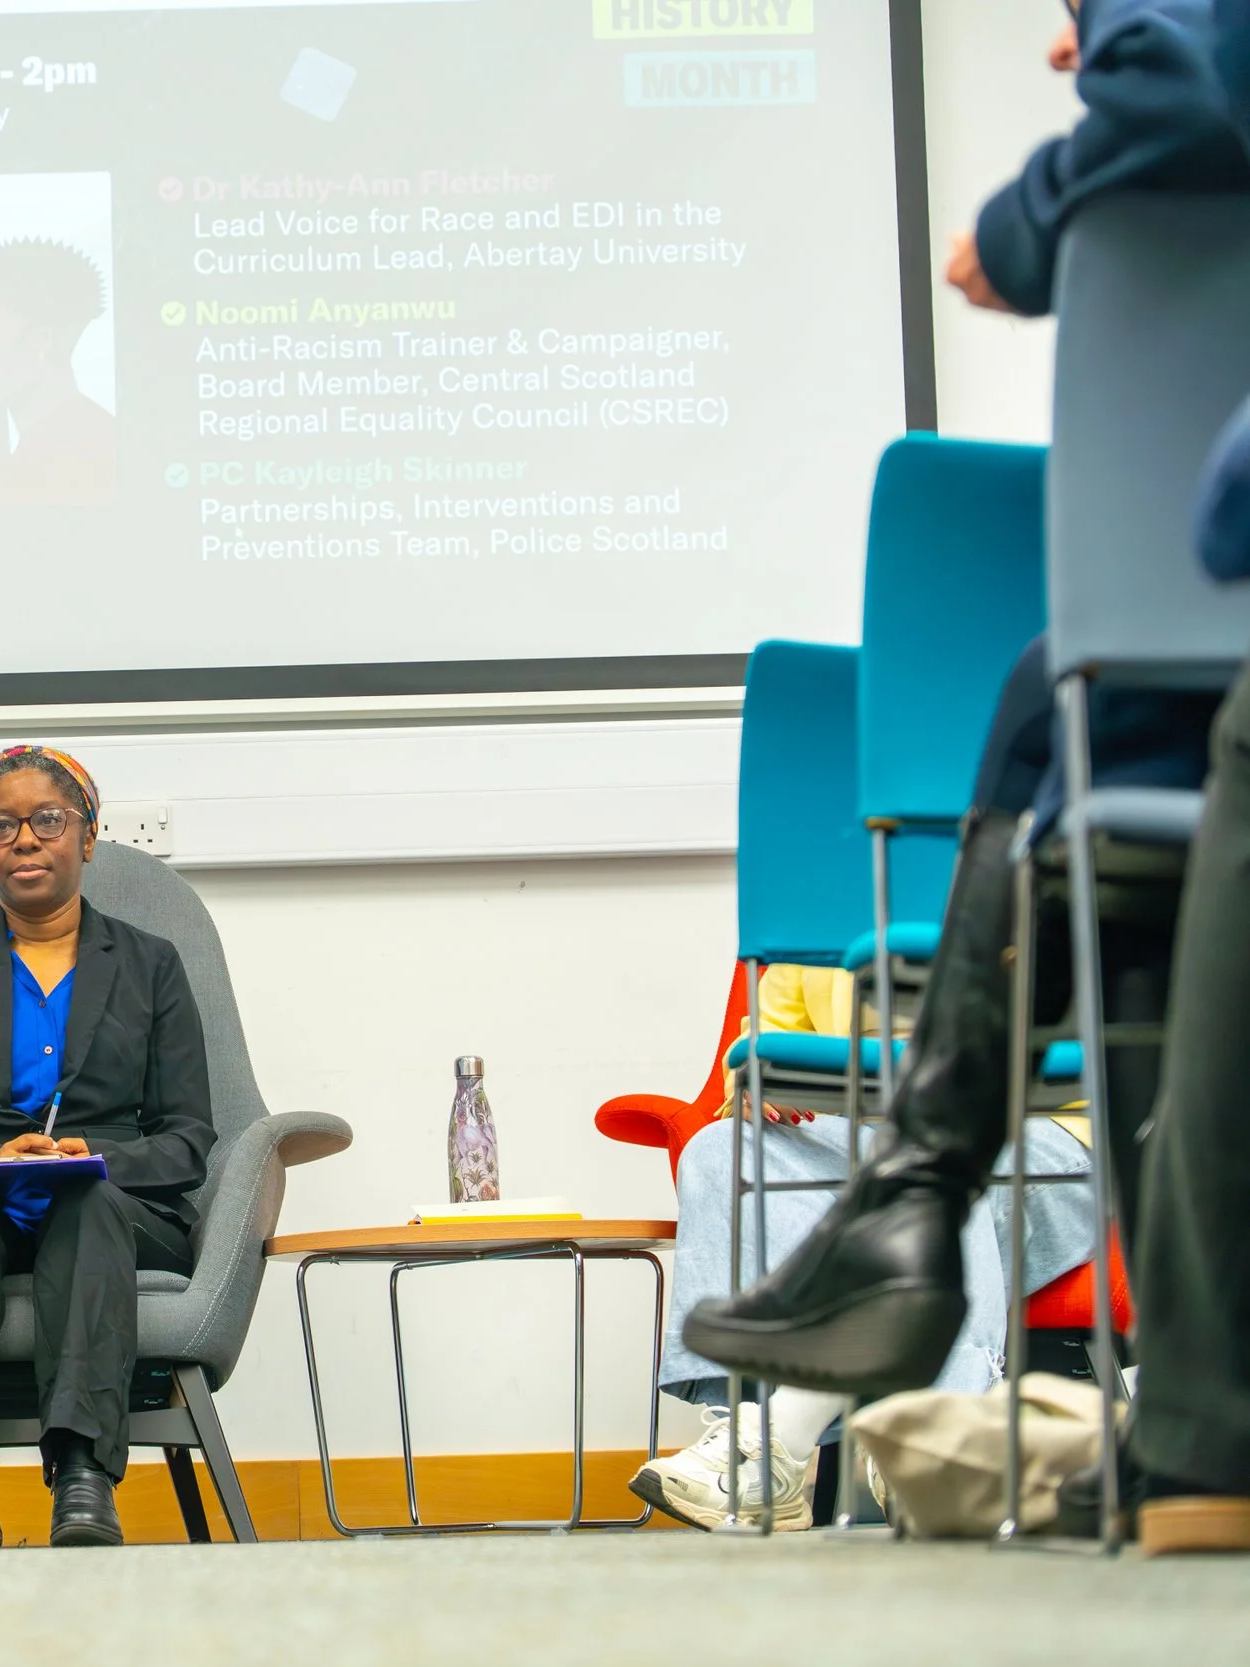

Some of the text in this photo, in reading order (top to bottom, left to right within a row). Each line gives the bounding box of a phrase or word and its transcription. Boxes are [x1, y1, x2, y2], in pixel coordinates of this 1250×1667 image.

[612, 0, 794, 30] HISTORY
[22, 56, 97, 92] 2pm
[641, 60, 799, 99] MONTH
[192, 167, 554, 203] Dr Kathy-Ann Fletcher
[194, 200, 723, 238] Lead Voice for Race and EDI in the
[194, 237, 747, 275] Curriculum Lead, Abertay University
[195, 297, 456, 328] Noomi Anyanwu
[196, 326, 730, 363] Anti-Racism Trainer & Campaigner,
[198, 361, 695, 399] Board Member, Central Scotland
[200, 396, 729, 441] Regional Equality Council (CSREC)
[200, 456, 528, 490] PC Kayleigh Skinner
[201, 486, 680, 526] Partnerships, Interventions and
[202, 524, 728, 561] Preventions Team, Police Scotland
